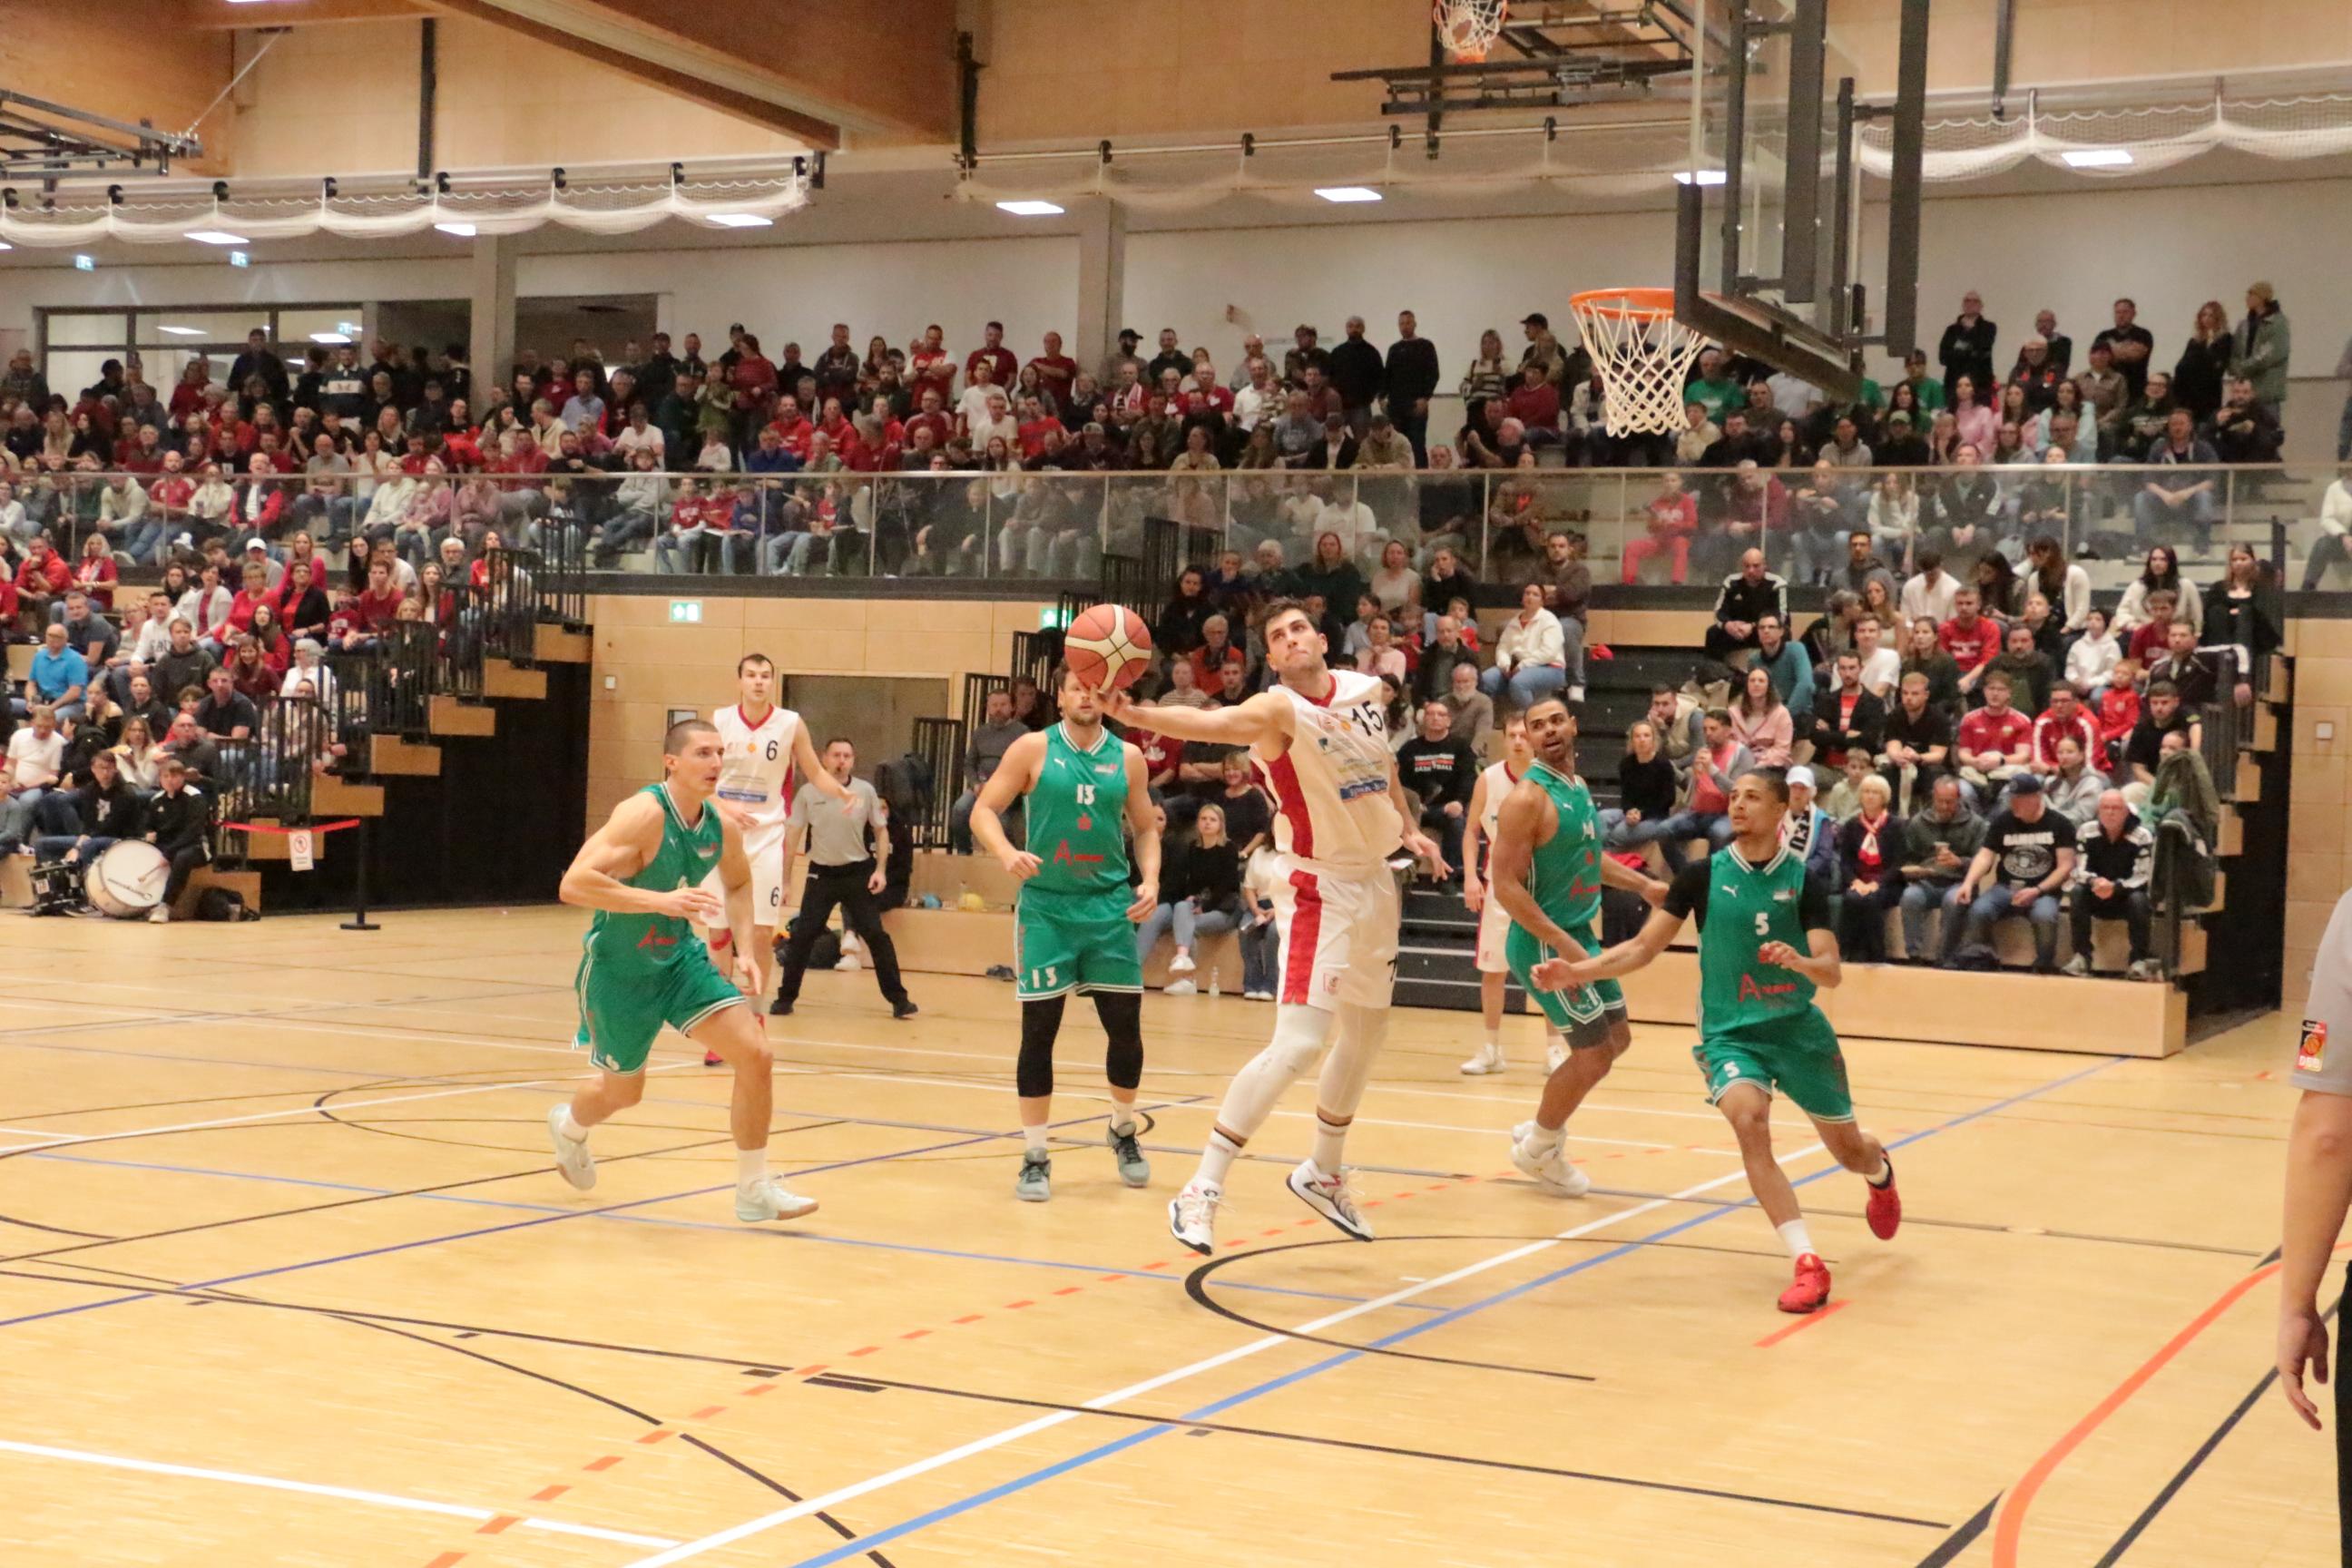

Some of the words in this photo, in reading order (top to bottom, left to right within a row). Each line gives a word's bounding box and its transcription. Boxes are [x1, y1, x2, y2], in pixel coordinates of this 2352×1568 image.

[1351, 700, 1384, 737] 15
[766, 740, 779, 761] 6
[1076, 783, 1096, 806] 13
[769, 886, 780, 907] 6
[1754, 912, 1770, 936] 5
[1032, 965, 1057, 989] 13
[1723, 1060, 1740, 1078] 5
